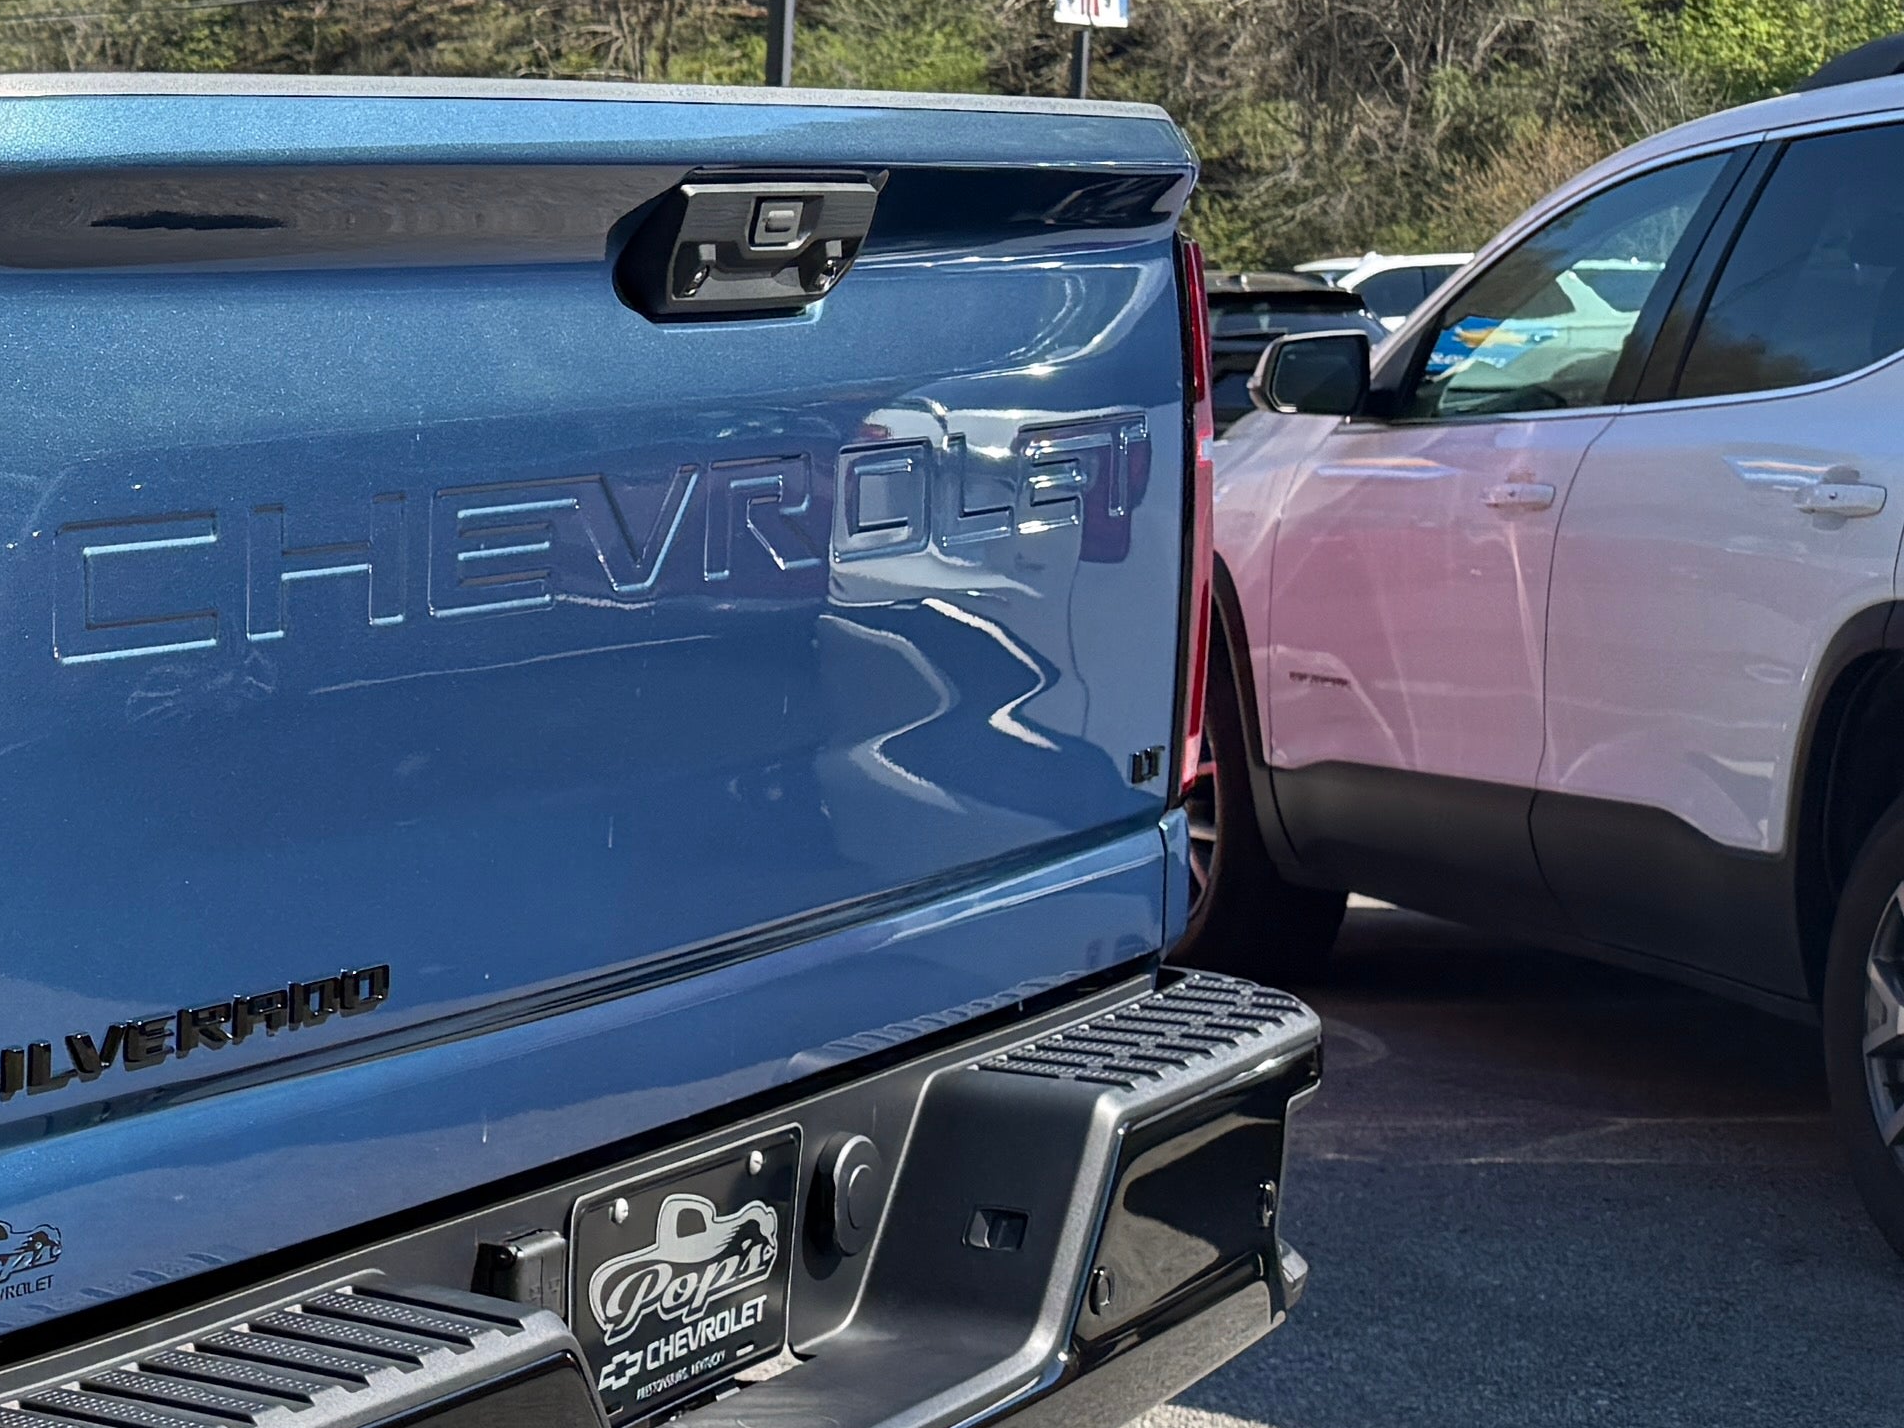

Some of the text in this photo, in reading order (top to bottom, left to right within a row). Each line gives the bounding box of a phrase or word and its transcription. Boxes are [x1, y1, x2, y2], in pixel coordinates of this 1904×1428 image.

[53, 411, 1151, 664] CHEVROLET
[605, 1238, 775, 1332] Pop's
[646, 1293, 768, 1372] CHEVROLET
